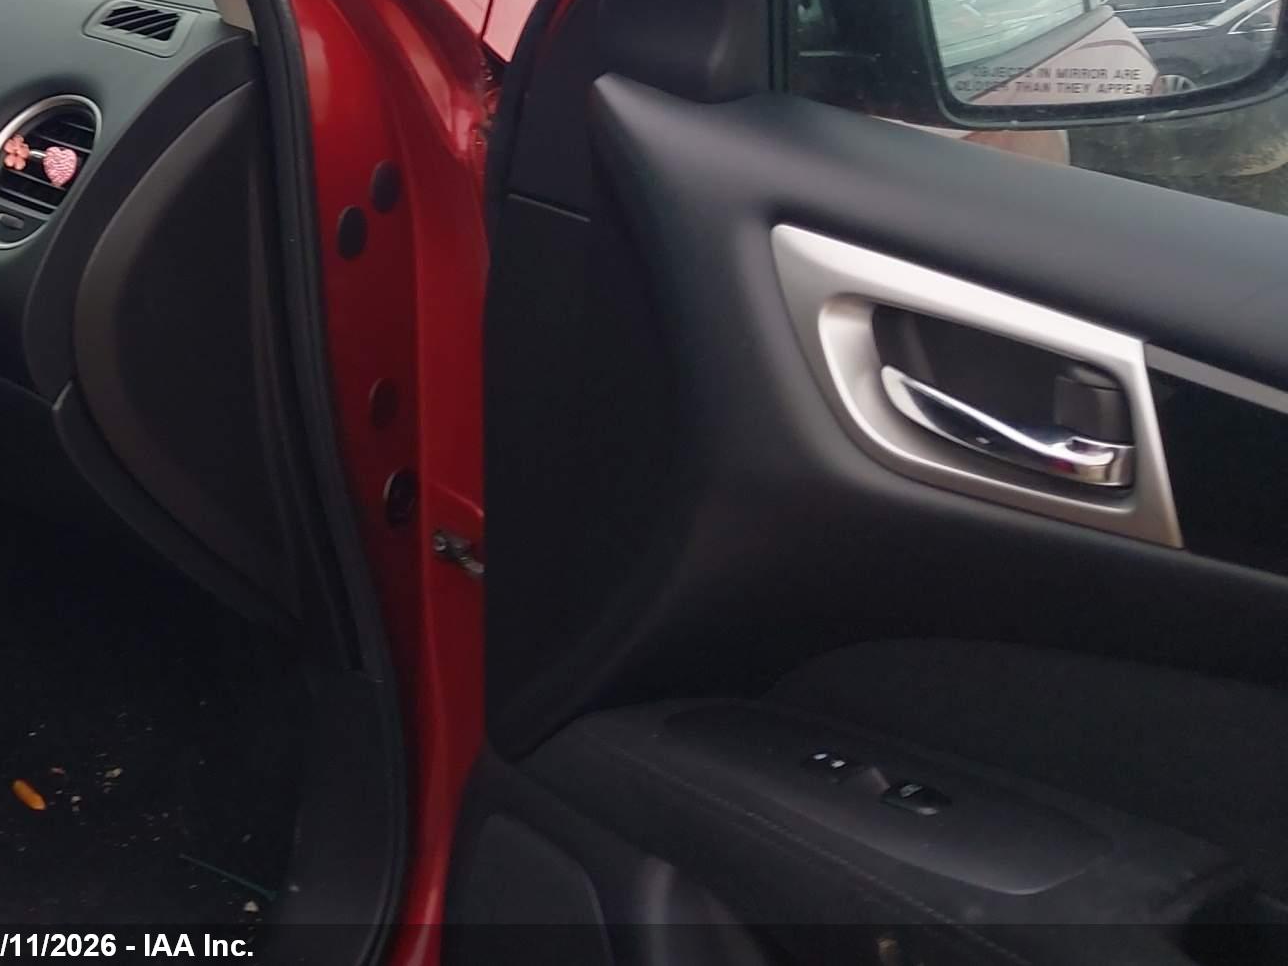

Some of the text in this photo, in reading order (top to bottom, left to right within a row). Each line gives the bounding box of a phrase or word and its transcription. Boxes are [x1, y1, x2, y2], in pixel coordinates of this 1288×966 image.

[1037, 67, 1051, 79] IN
[1056, 68, 1108, 79] MIRROR
[1114, 68, 1142, 80] ARE
[1015, 81, 1051, 92] THAN
[1056, 82, 1091, 94] THEY
[1097, 83, 1153, 95] APPEAR
